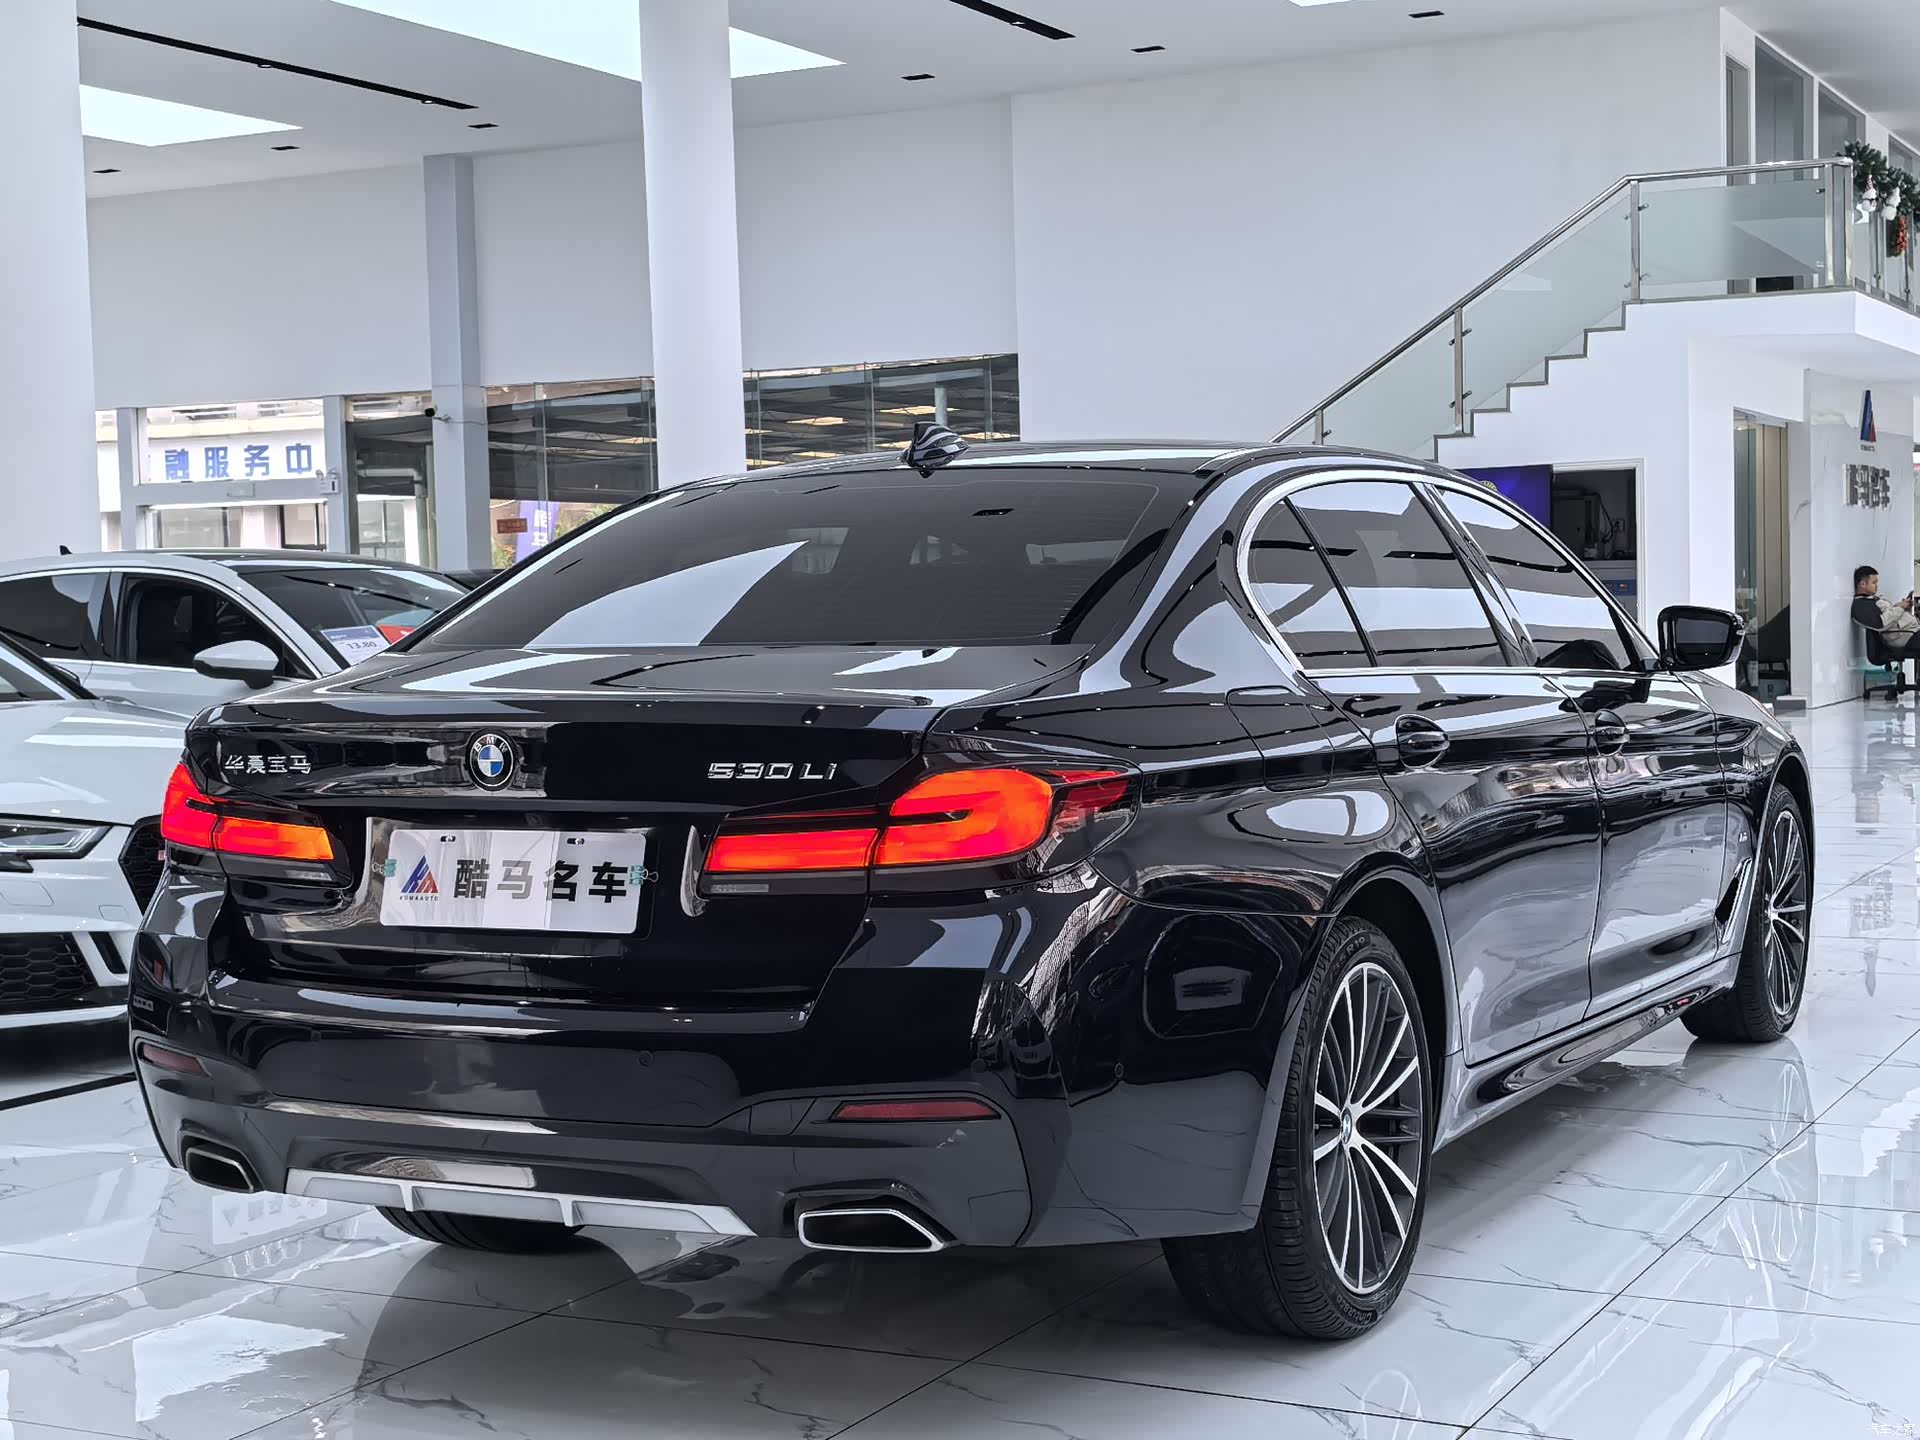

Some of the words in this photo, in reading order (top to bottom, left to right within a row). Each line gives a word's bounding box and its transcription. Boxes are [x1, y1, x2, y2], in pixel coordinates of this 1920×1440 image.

[164, 443, 312, 480] 融服务中
[473, 736, 509, 753] BMW
[224, 754, 312, 775] 华晨宝马
[707, 762, 794, 780] 530
[452, 858, 629, 903] 酷马名车
